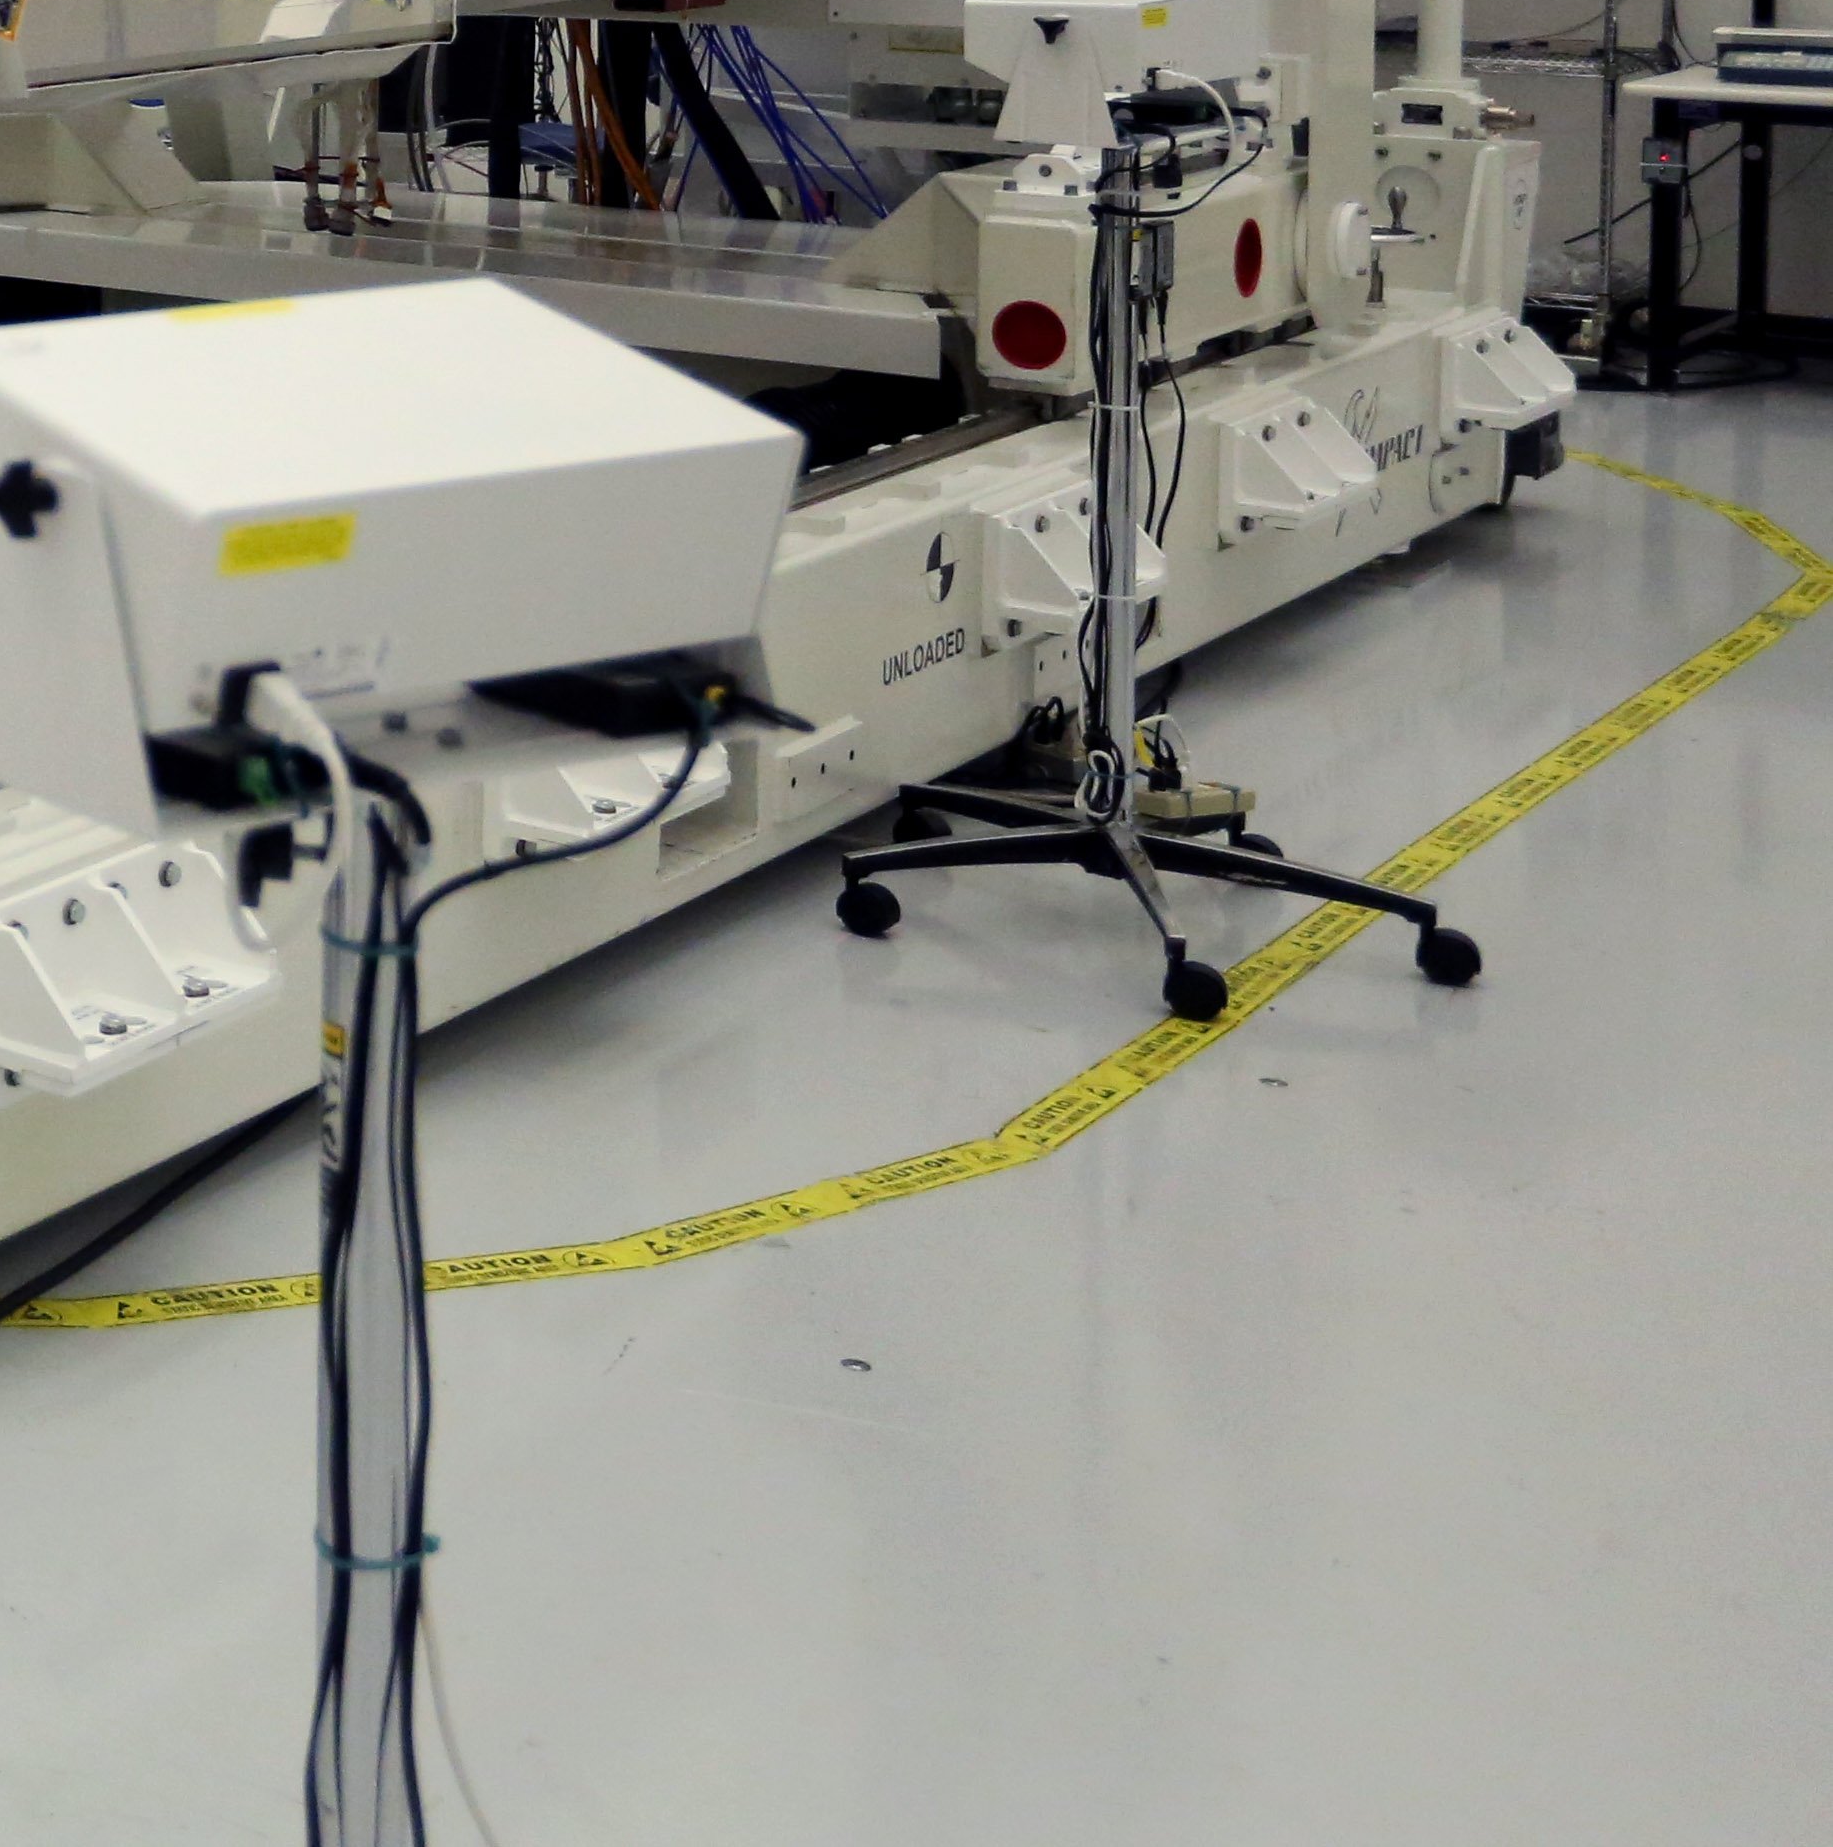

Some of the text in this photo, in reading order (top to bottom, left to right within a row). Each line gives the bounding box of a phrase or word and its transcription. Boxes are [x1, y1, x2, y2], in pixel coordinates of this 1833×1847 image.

[882, 627, 965, 686] UNLOADED
[868, 1154, 953, 1186] CAUTION
[150, 1282, 280, 1306] CAUTION
